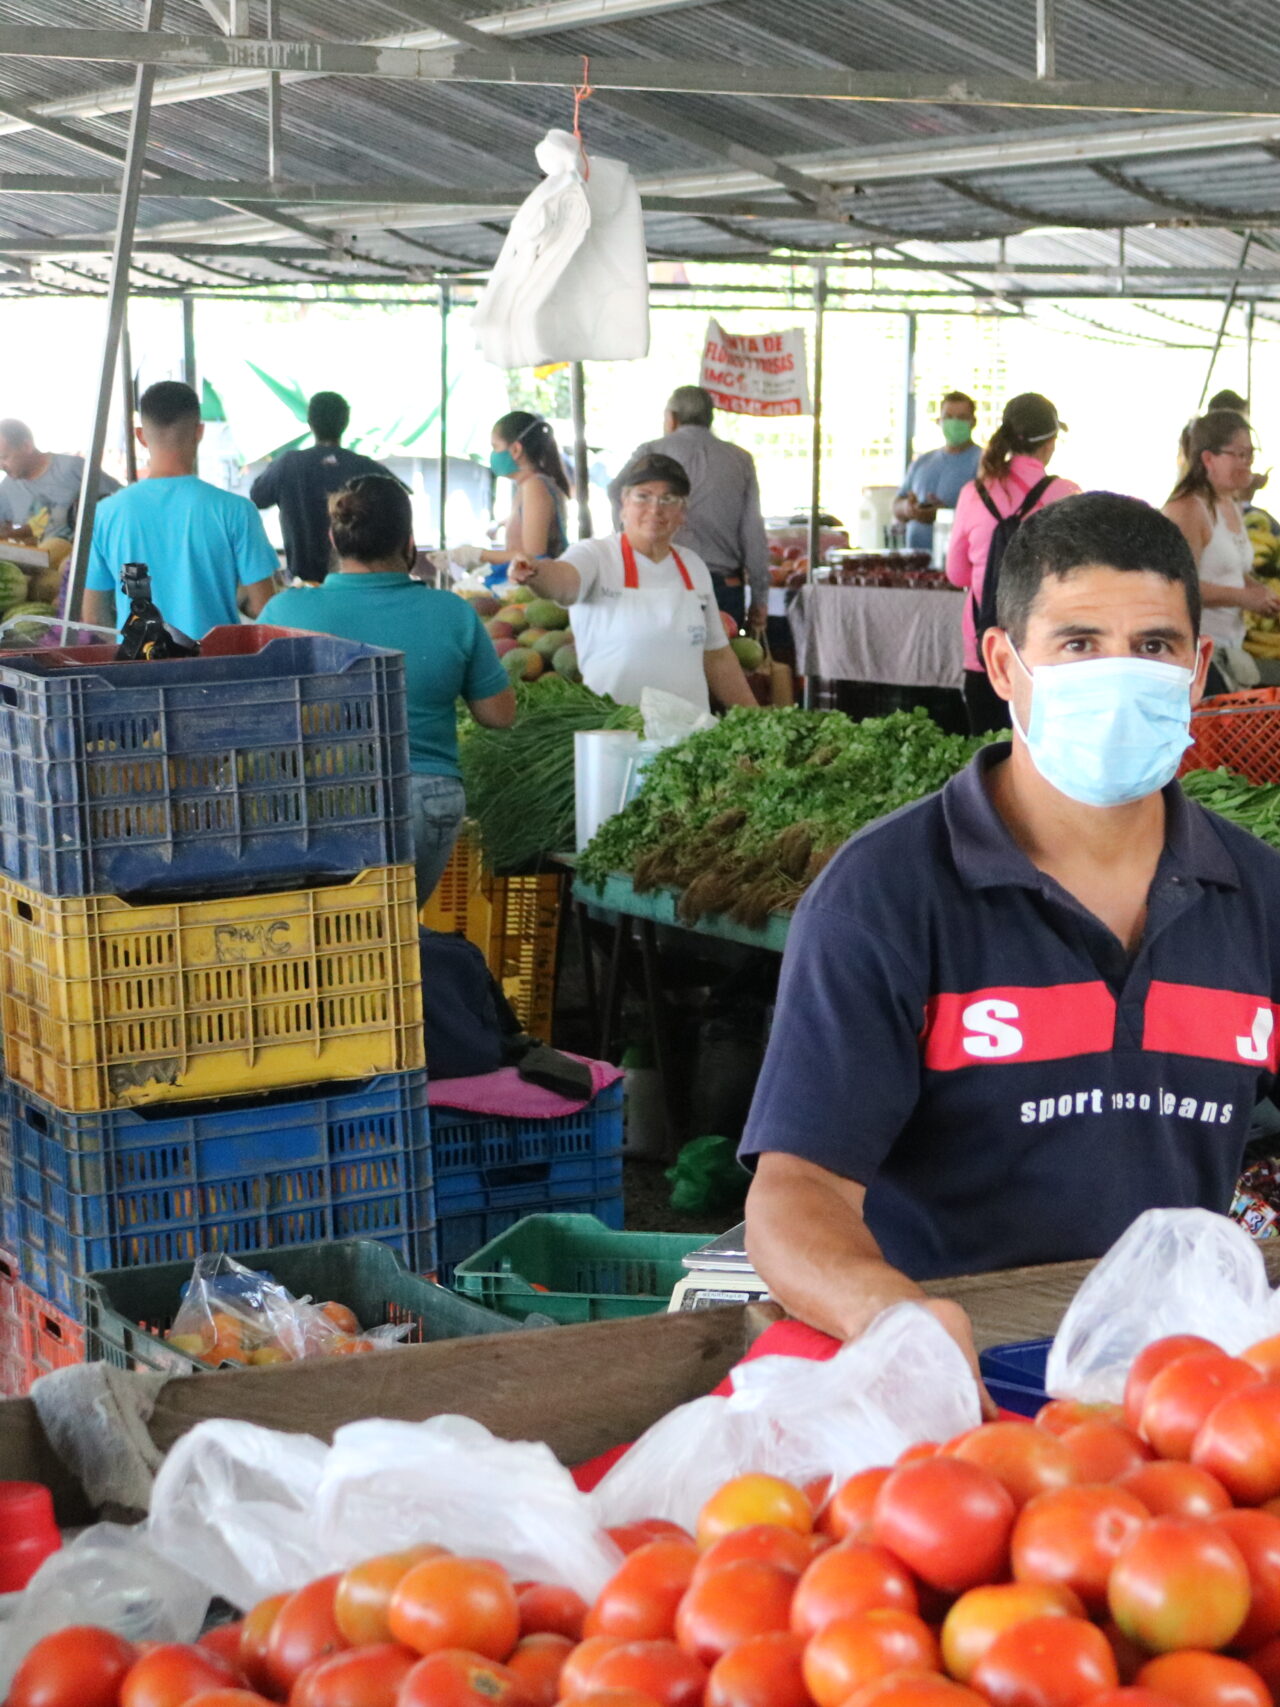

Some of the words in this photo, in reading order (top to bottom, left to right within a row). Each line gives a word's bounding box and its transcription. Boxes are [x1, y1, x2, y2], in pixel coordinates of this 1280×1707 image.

[763, 335, 783, 352] DE
[962, 999, 1023, 1058] S
[1236, 1007, 1274, 1061] J
[1020, 1088, 1103, 1124] sport
[1111, 1092, 1151, 1110] 1930
